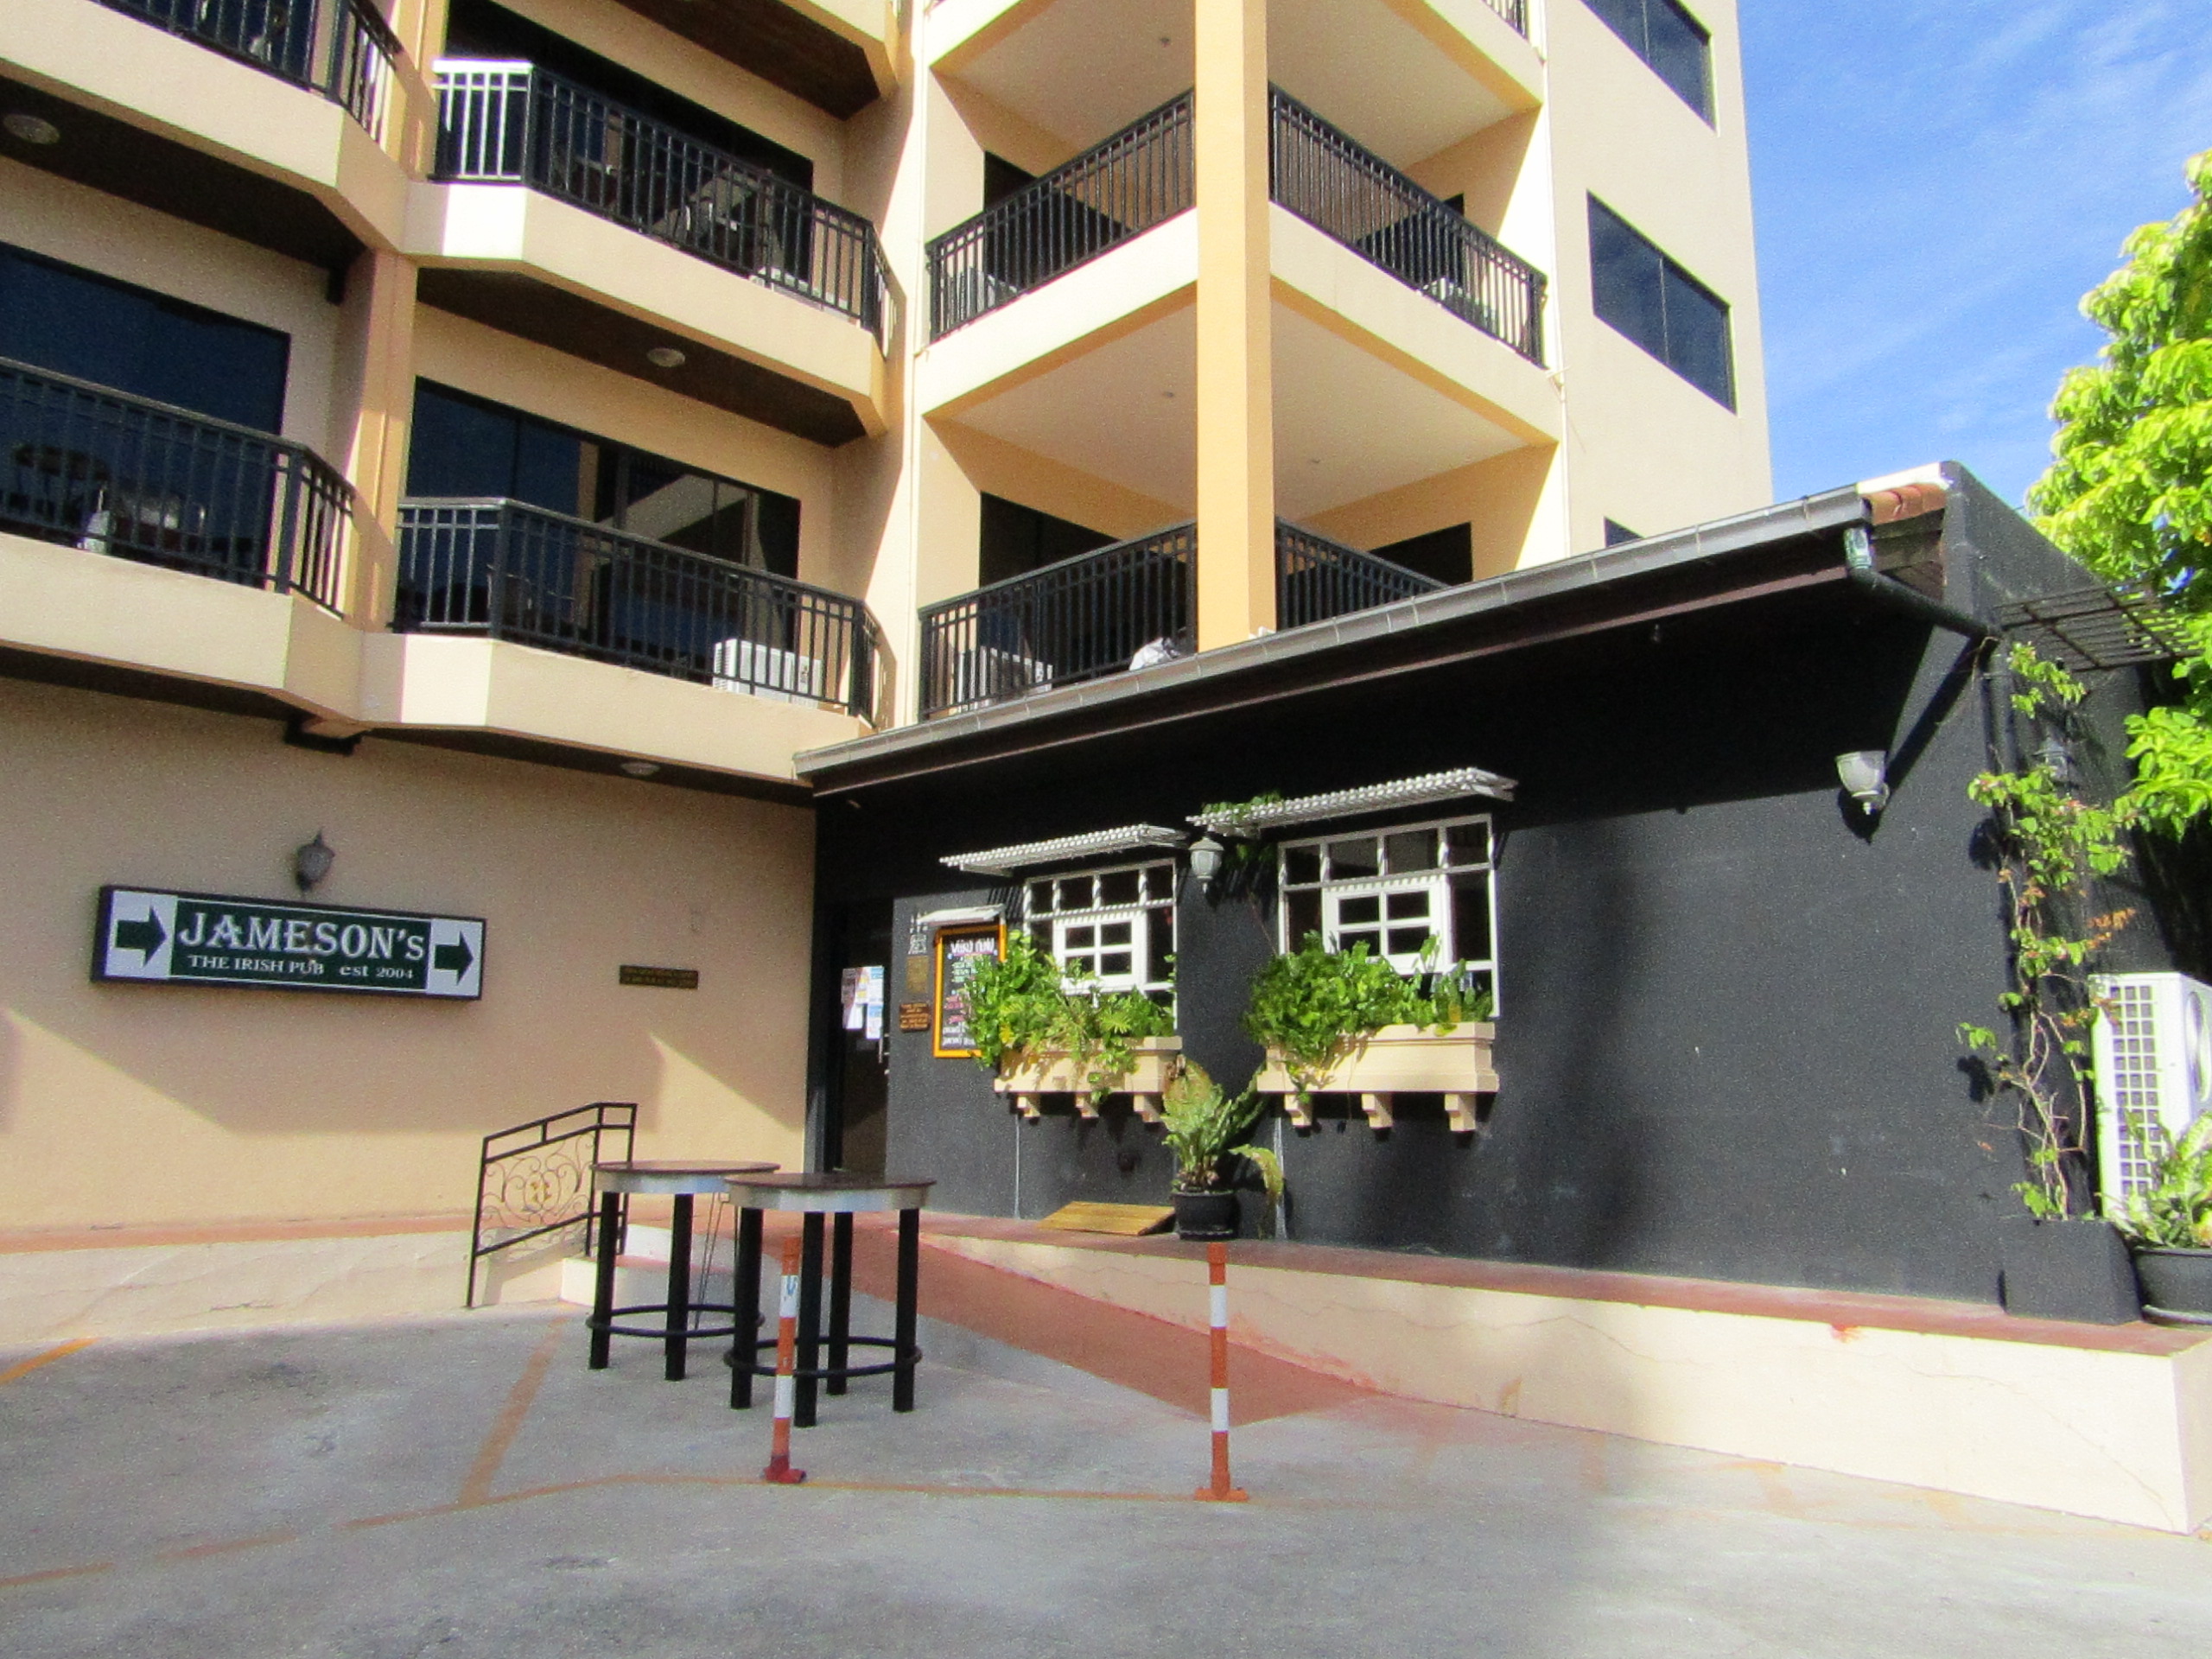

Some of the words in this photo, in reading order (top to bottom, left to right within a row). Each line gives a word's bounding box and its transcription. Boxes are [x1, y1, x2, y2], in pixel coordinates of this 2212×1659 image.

[188, 954, 231, 969] THE
[234, 957, 284, 973] IRISH
[289, 961, 325, 976] PUB
[375, 967, 415, 979] 2004
